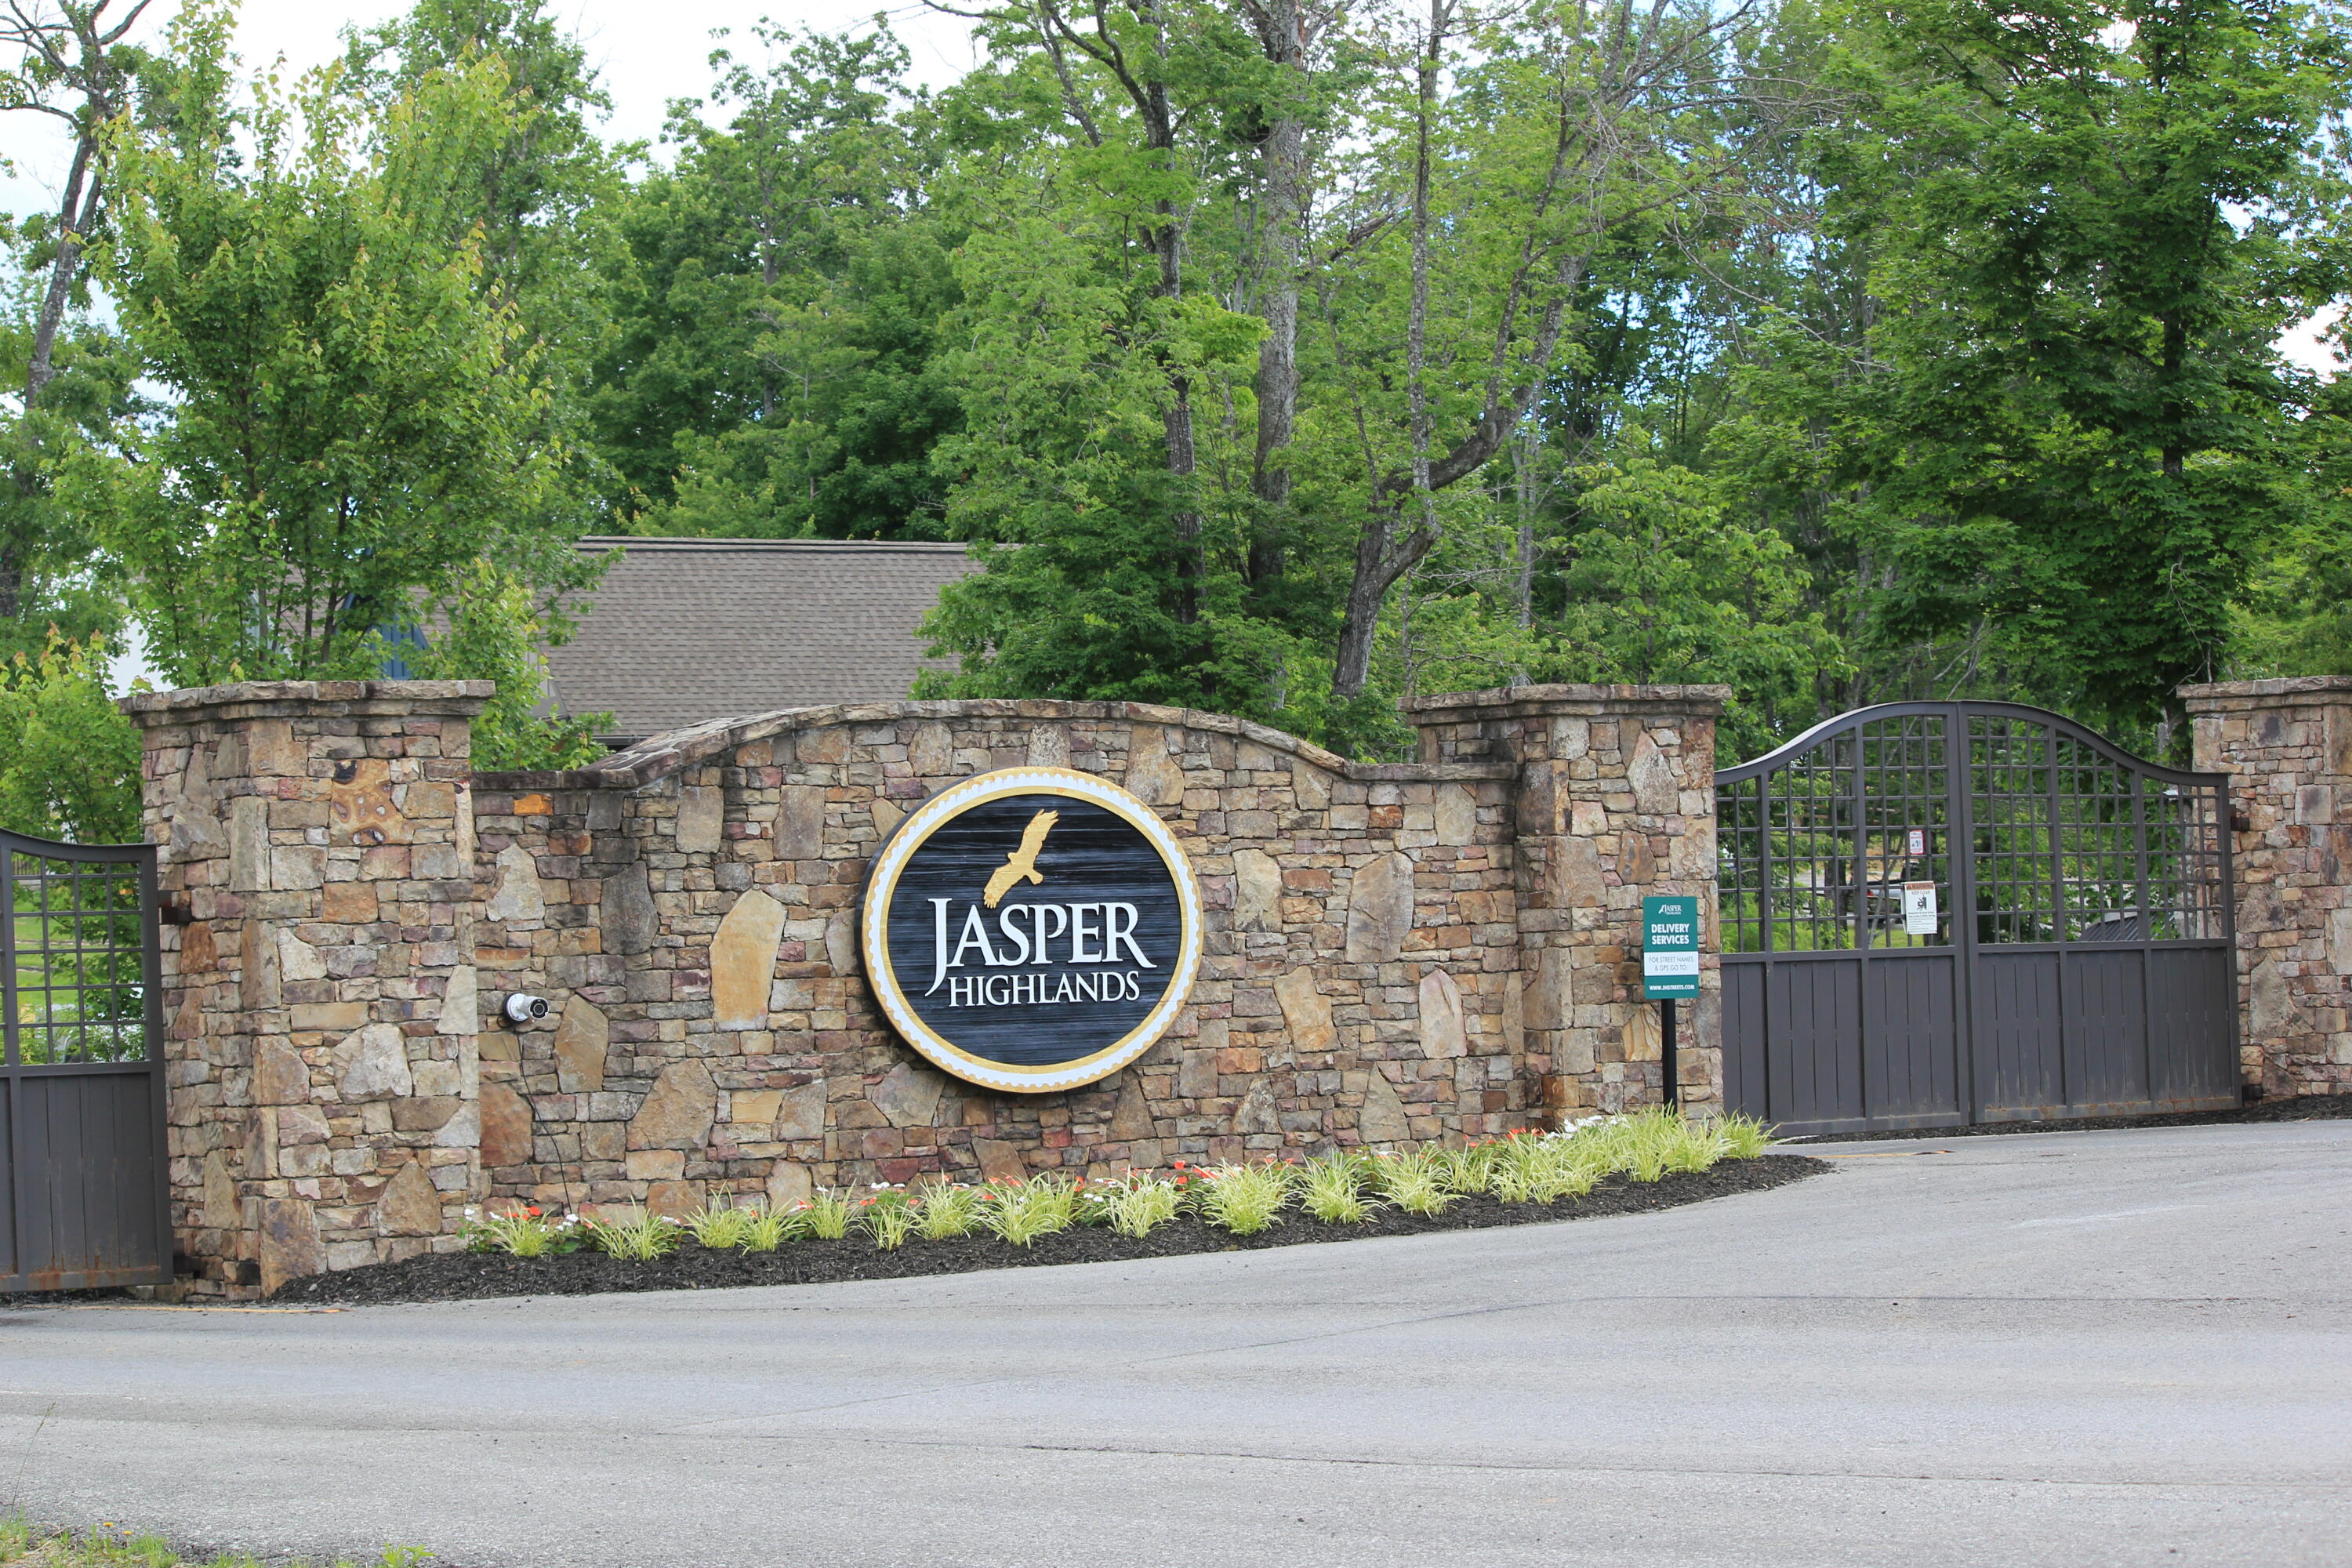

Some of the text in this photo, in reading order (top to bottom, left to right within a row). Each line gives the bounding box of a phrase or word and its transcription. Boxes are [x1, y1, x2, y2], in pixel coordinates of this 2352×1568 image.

[1651, 923, 1690, 933] DELIVERY
[924, 898, 1157, 997] JASPER
[1651, 935, 1690, 945] SERVICES
[948, 971, 1140, 1007] HIGHLANDS
